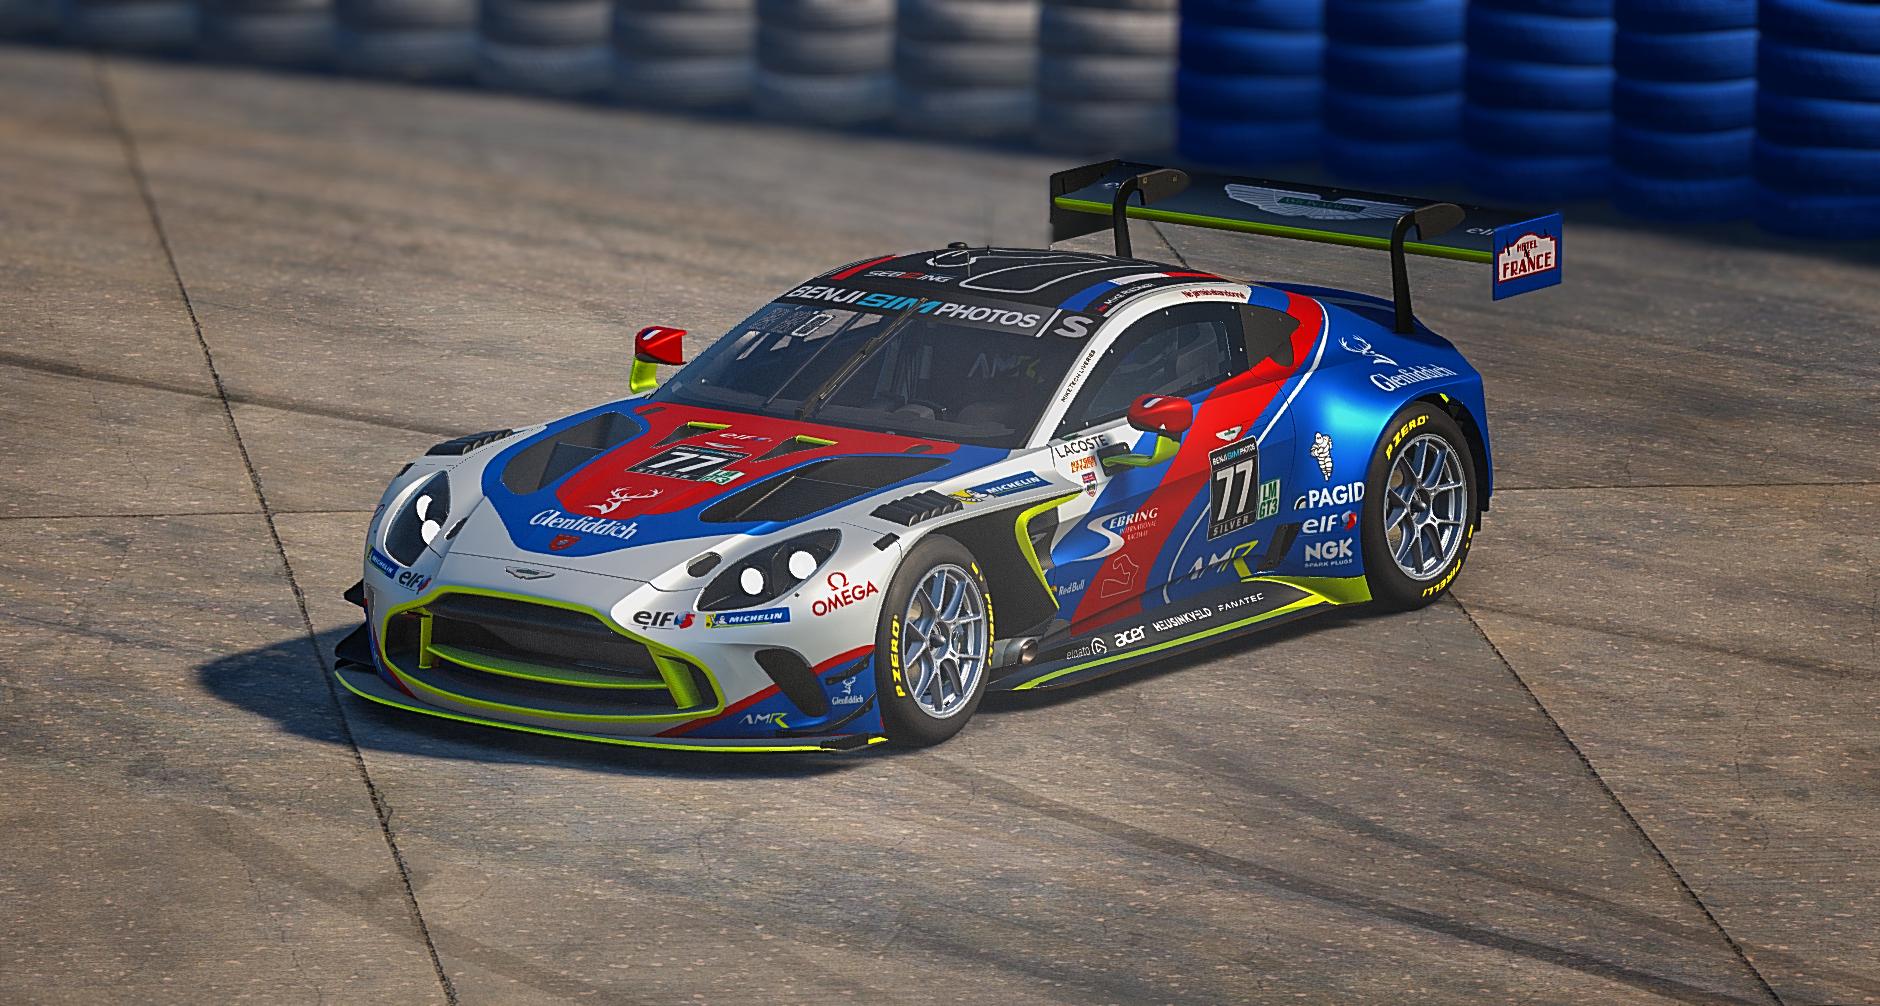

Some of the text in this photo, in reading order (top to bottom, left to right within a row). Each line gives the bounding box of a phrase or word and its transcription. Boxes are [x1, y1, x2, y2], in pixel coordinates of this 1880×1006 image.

[1502, 252, 1552, 279] FRANCE
[933, 302, 1042, 329] PHOTOS
[1053, 315, 1094, 338] S
[1369, 363, 1459, 392] Glenfiddich
[1054, 434, 1109, 459] LACOSTE
[637, 467, 691, 479] SILVER
[647, 451, 729, 473] 77
[985, 475, 1041, 494] MICHELIN
[1216, 458, 1254, 522] 77
[1262, 481, 1277, 501] LM
[1308, 481, 1365, 509] PAGID
[1259, 498, 1278, 518] GT3
[529, 509, 638, 540] Glenfiddich
[1212, 515, 1250, 537] SILVER
[1301, 513, 1339, 534] elf
[1176, 539, 1259, 582] AMR
[1304, 537, 1353, 562] NGK
[372, 554, 395, 574] MICHELIN
[1304, 558, 1353, 569] SPARK PLUGS
[398, 570, 425, 589] elf
[1422, 558, 1462, 598] PIRELLI
[811, 580, 880, 617] OMEGA
[1216, 592, 1265, 613] FANATEC
[633, 610, 676, 627] elf
[728, 611, 783, 624] MICHELIN
[1152, 607, 1213, 632] HEUSINKVELD
[1114, 625, 1145, 648] acer
[831, 694, 864, 706] Glenfiddich
[738, 711, 790, 729] AMR
